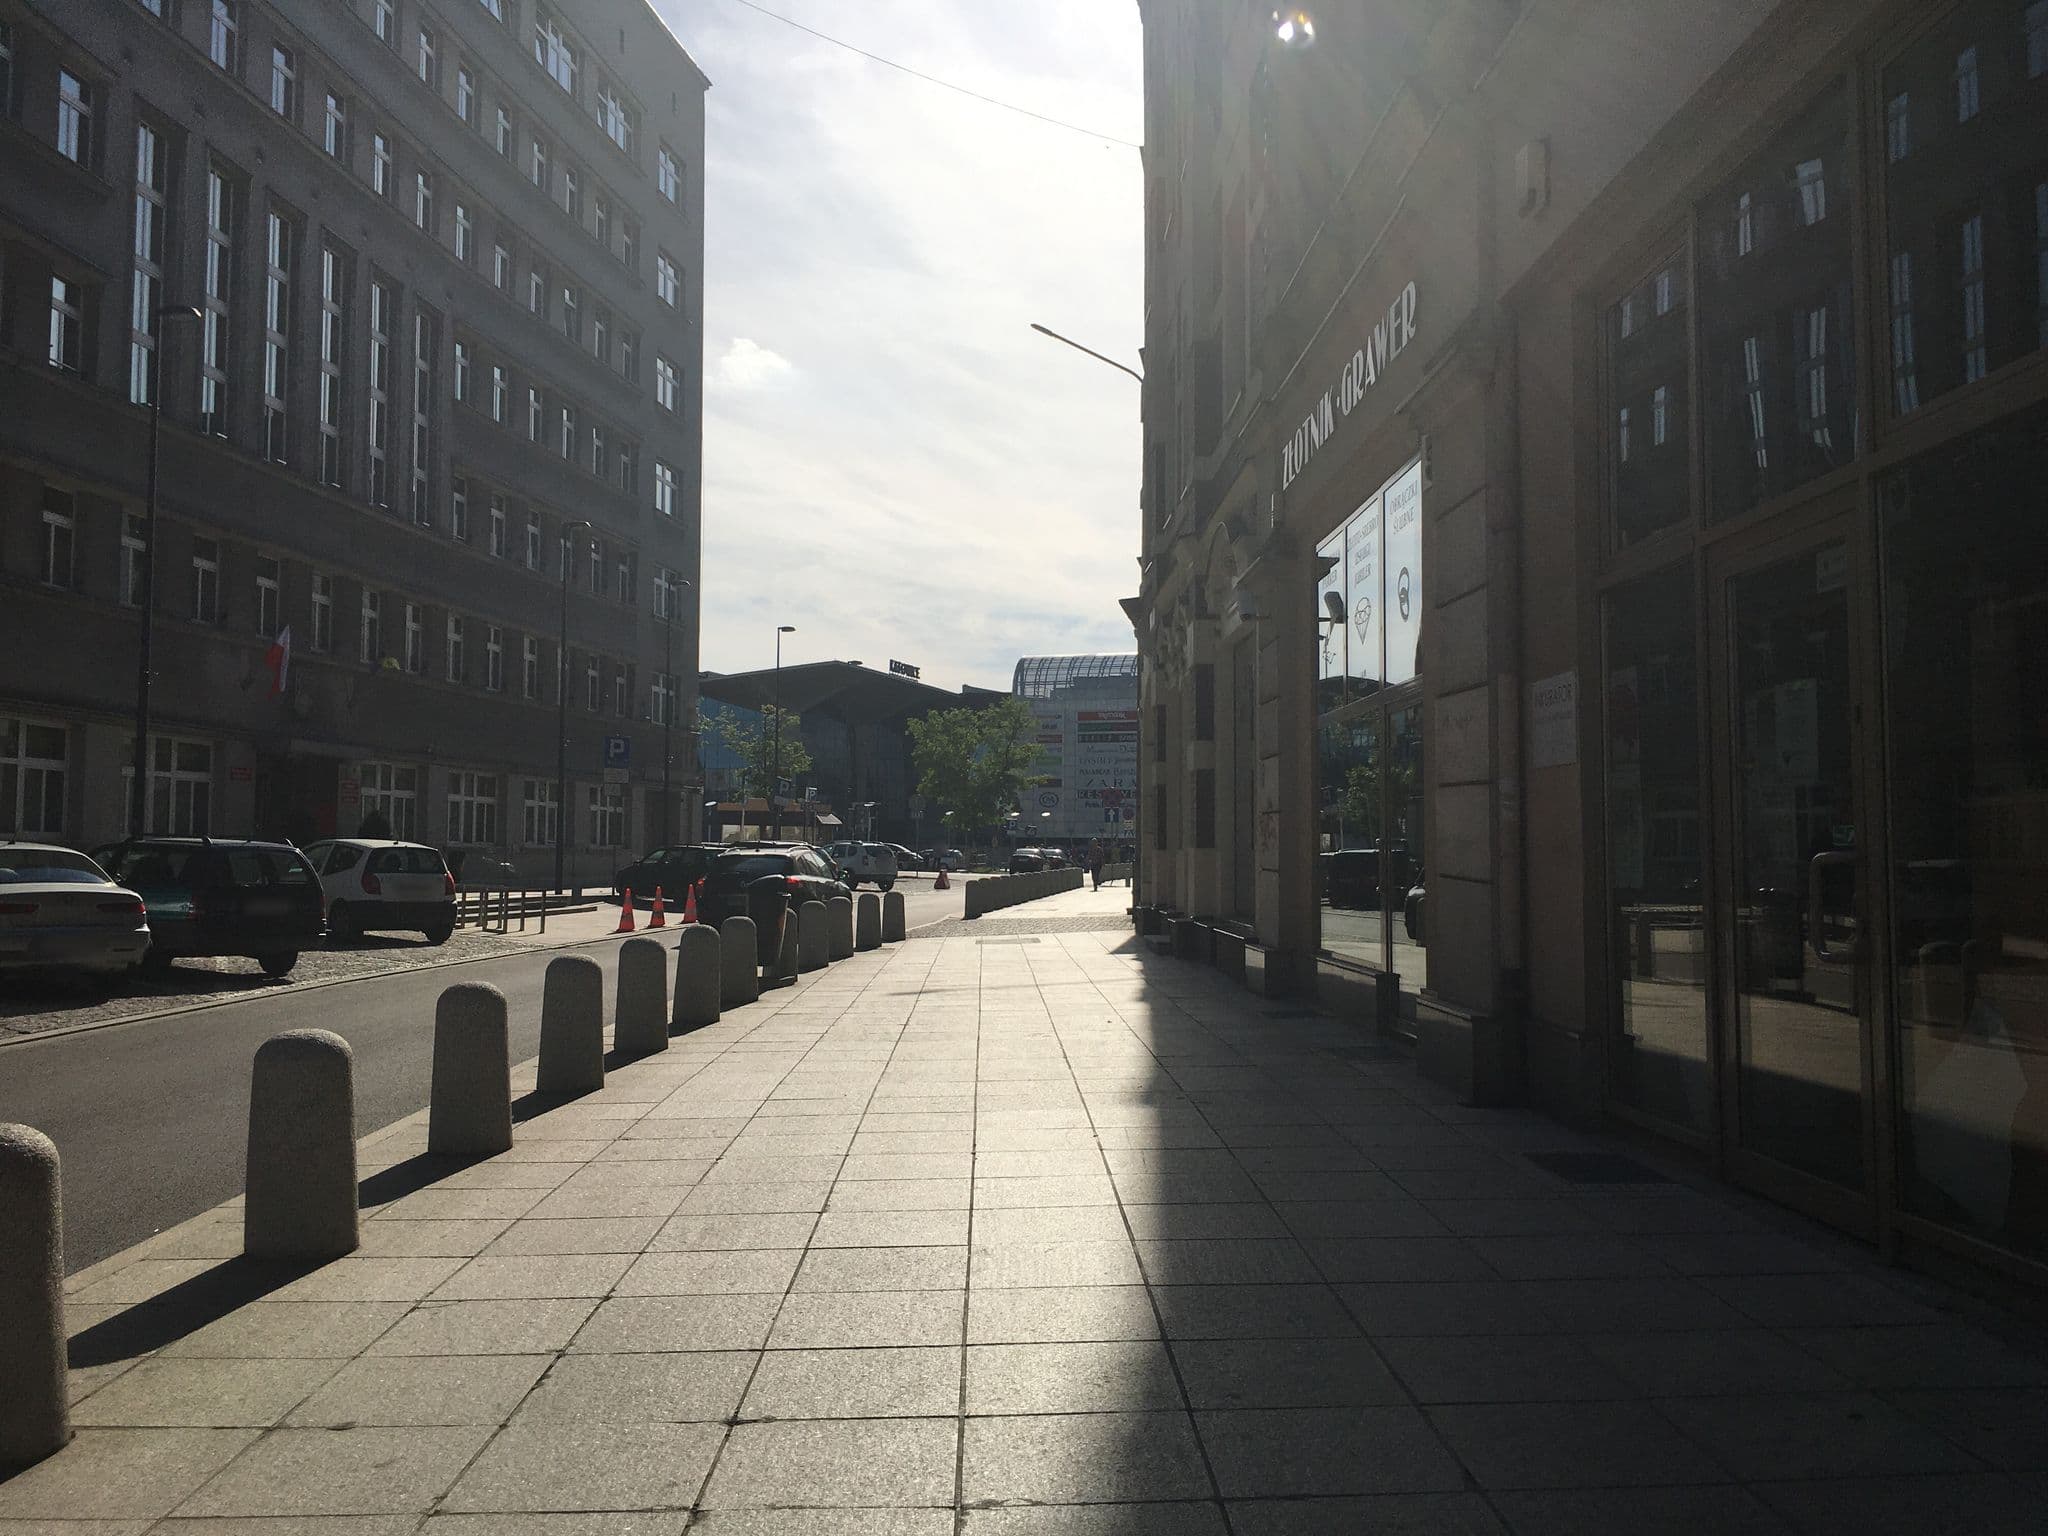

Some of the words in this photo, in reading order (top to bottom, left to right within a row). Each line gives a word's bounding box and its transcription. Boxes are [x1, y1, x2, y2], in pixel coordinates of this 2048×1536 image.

[1282, 385, 1334, 491] ZŁOTNIK
[1340, 280, 1417, 417] GRAWER
[609, 739, 625, 759] P
